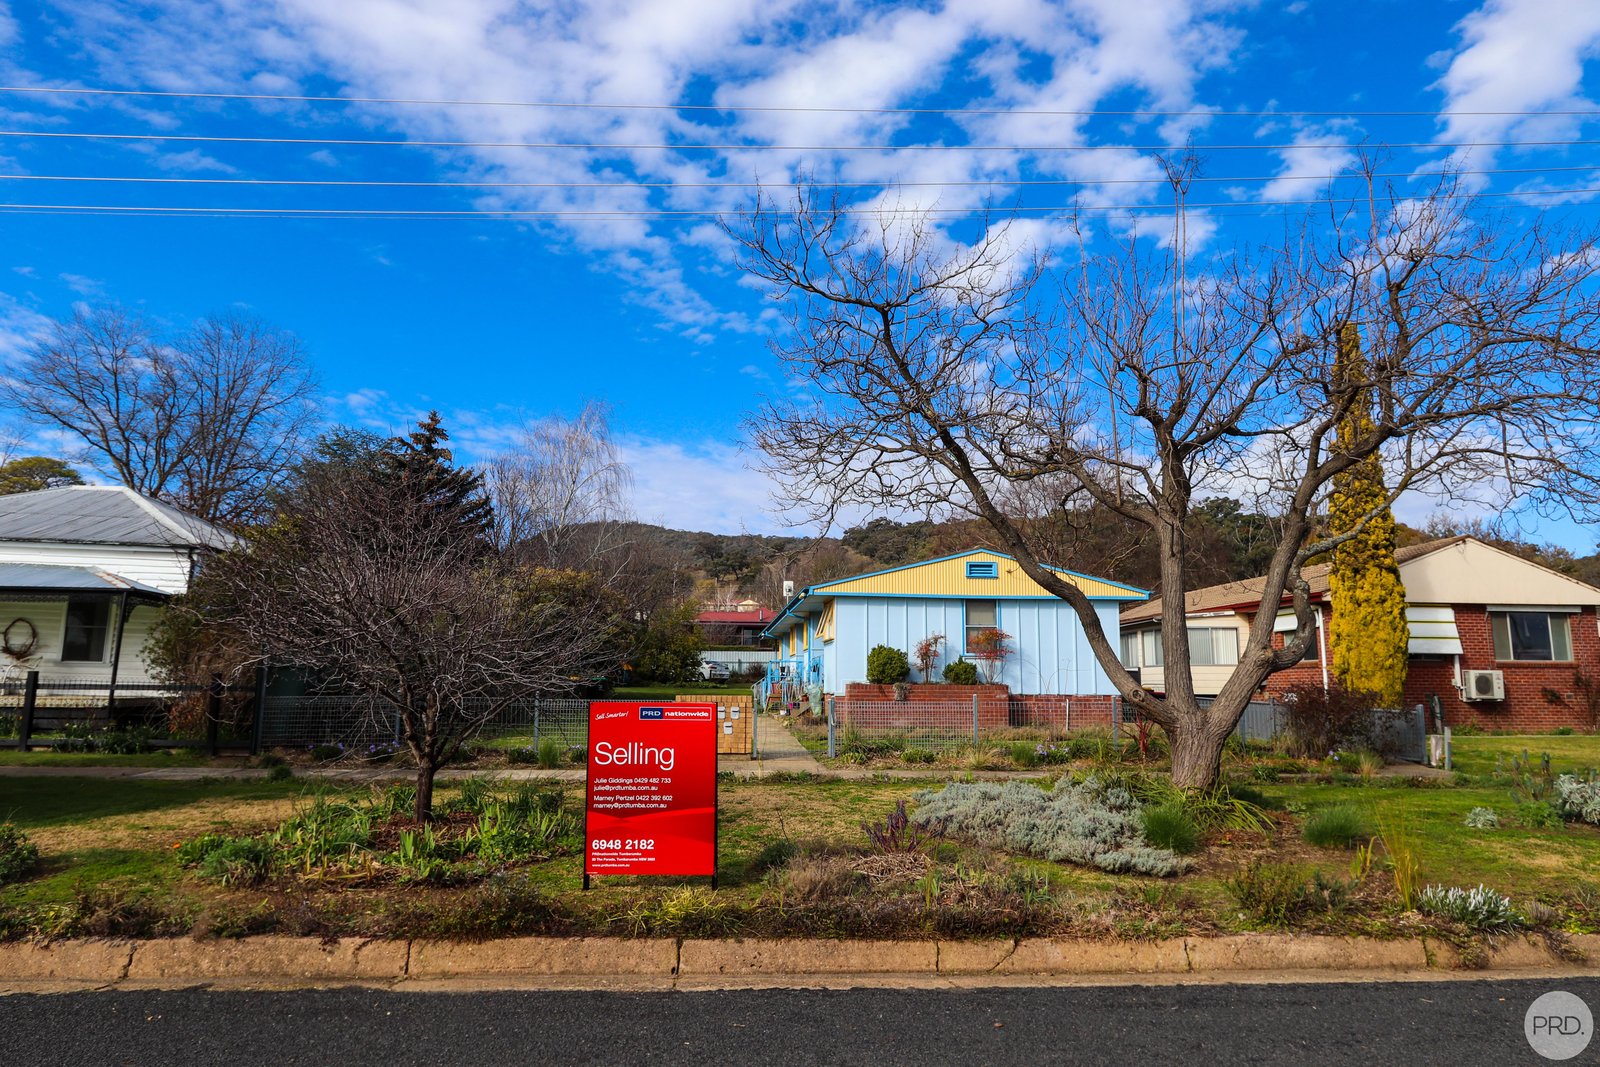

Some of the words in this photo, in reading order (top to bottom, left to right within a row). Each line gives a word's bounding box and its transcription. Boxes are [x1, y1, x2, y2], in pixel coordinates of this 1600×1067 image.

[594, 742, 675, 771] Selling
[592, 839, 621, 850] 6948
[625, 839, 655, 850] 2182
